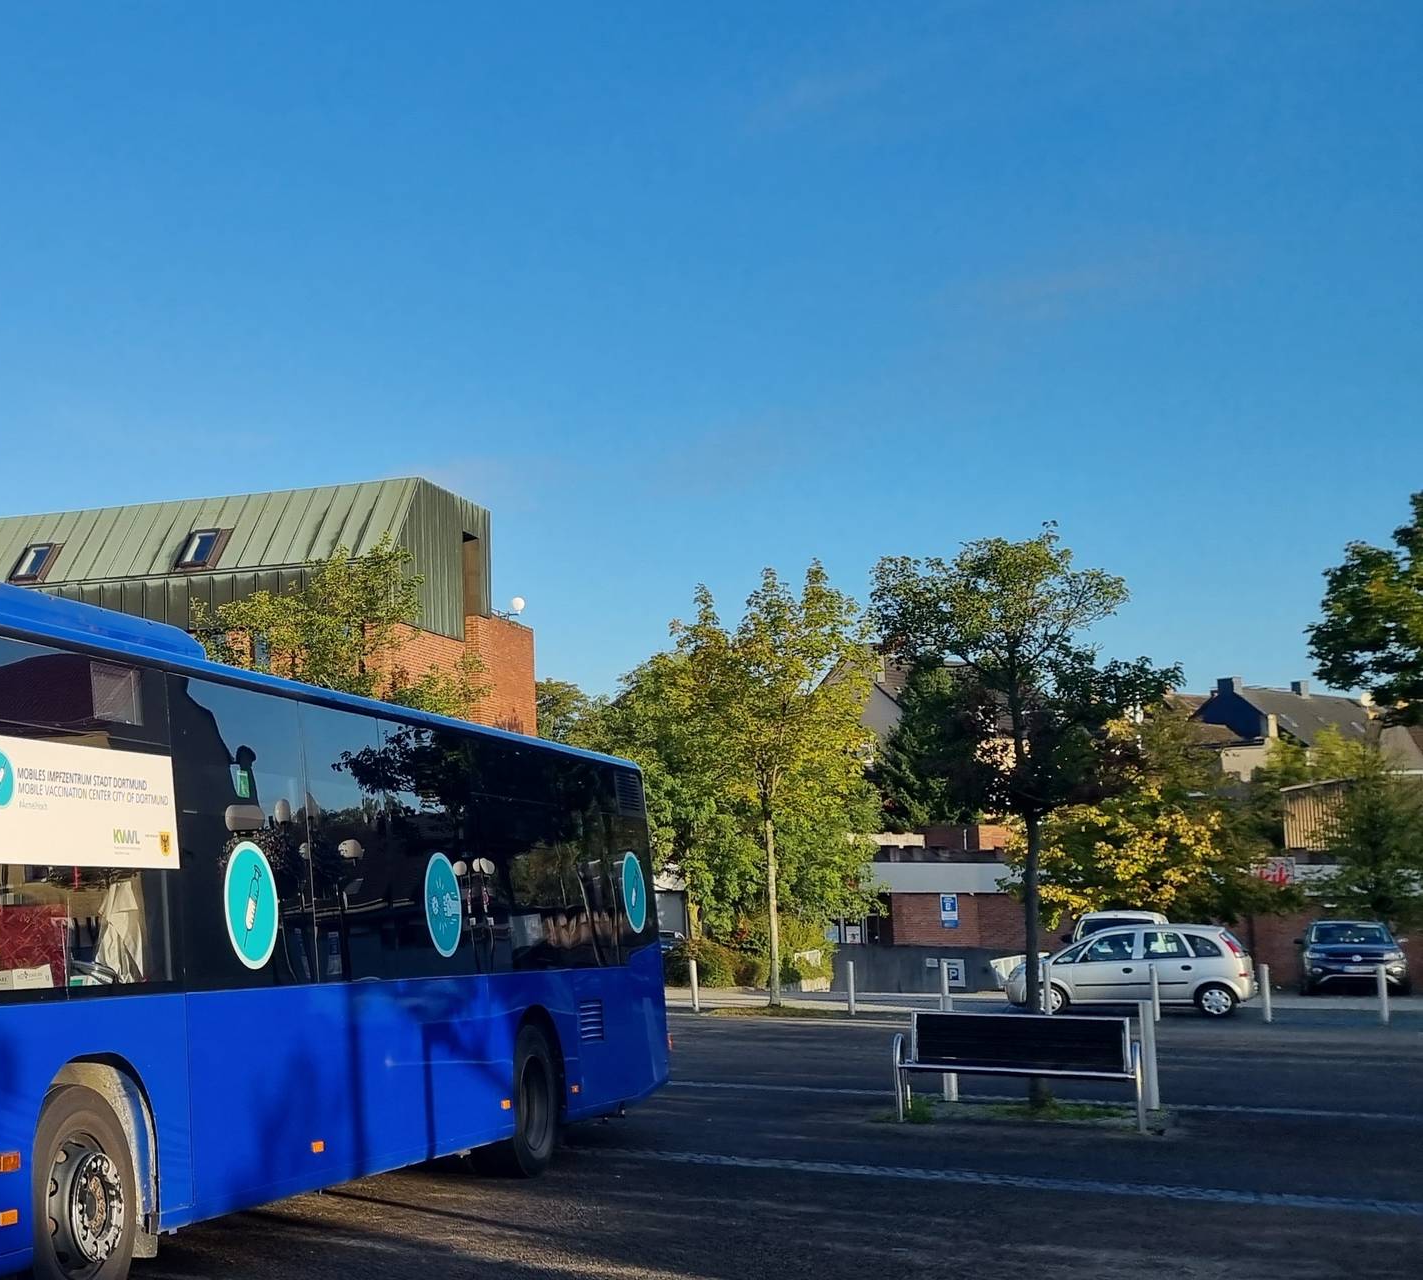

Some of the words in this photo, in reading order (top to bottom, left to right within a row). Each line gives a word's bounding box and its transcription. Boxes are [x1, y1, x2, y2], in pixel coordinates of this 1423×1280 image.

[17, 768, 46, 781] MOBILES
[47, 771, 92, 786] IMPFZENTRUM
[93, 775, 112, 788] STADT
[113, 777, 147, 791] DORTMUND
[18, 783, 44, 796] MOBILE
[44, 785, 87, 800] VACCINATION
[88, 789, 111, 802] CENTER
[112, 792, 125, 803] CITY
[126, 793, 135, 804] OF
[135, 794, 169, 806] DORTMUND
